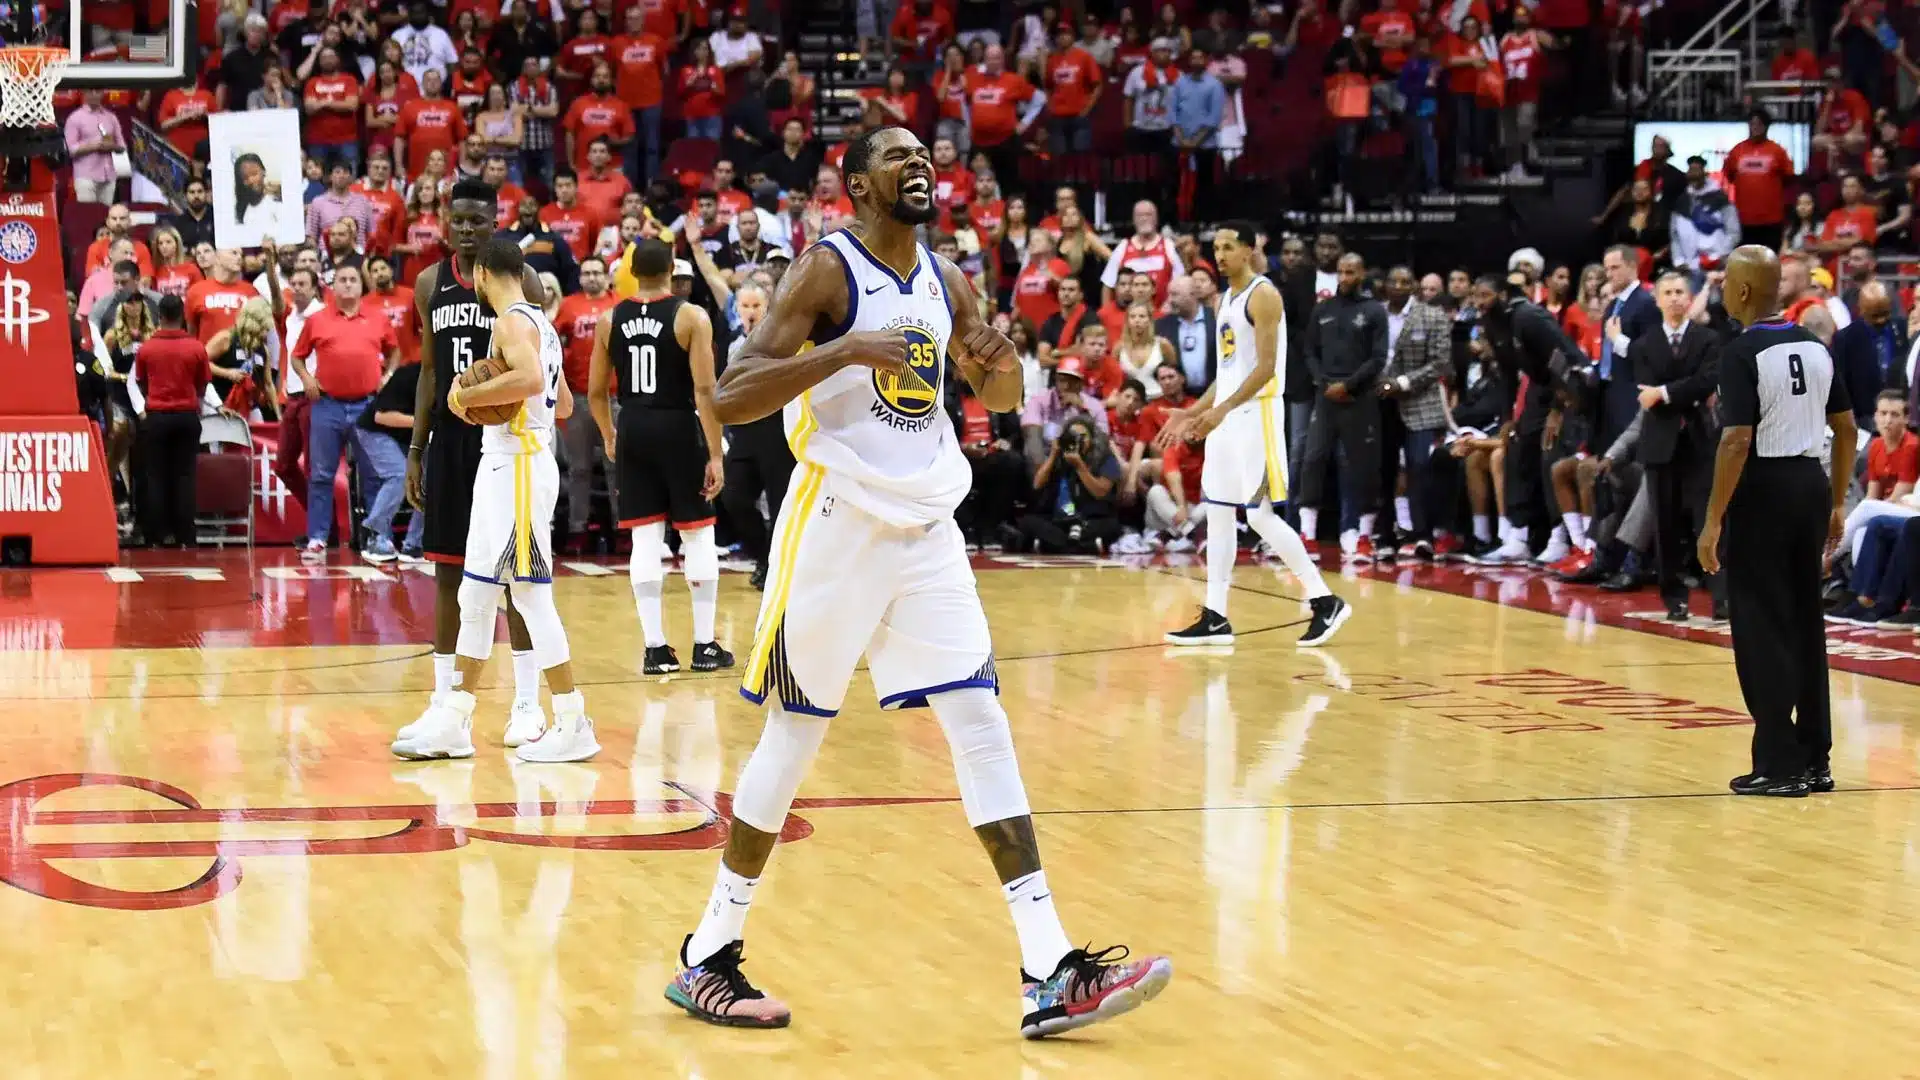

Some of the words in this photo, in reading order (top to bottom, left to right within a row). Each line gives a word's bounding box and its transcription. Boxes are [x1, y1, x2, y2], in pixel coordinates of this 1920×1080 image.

[621, 317, 664, 339] GORDON
[452, 336, 473, 373] 15
[628, 344, 657, 394] 10
[909, 342, 935, 368] 35
[1788, 353, 1808, 396] 9
[870, 399, 939, 433] WARRIORS
[0, 431, 89, 472] ESTERN
[1442, 668, 1756, 730] TOYOTA
